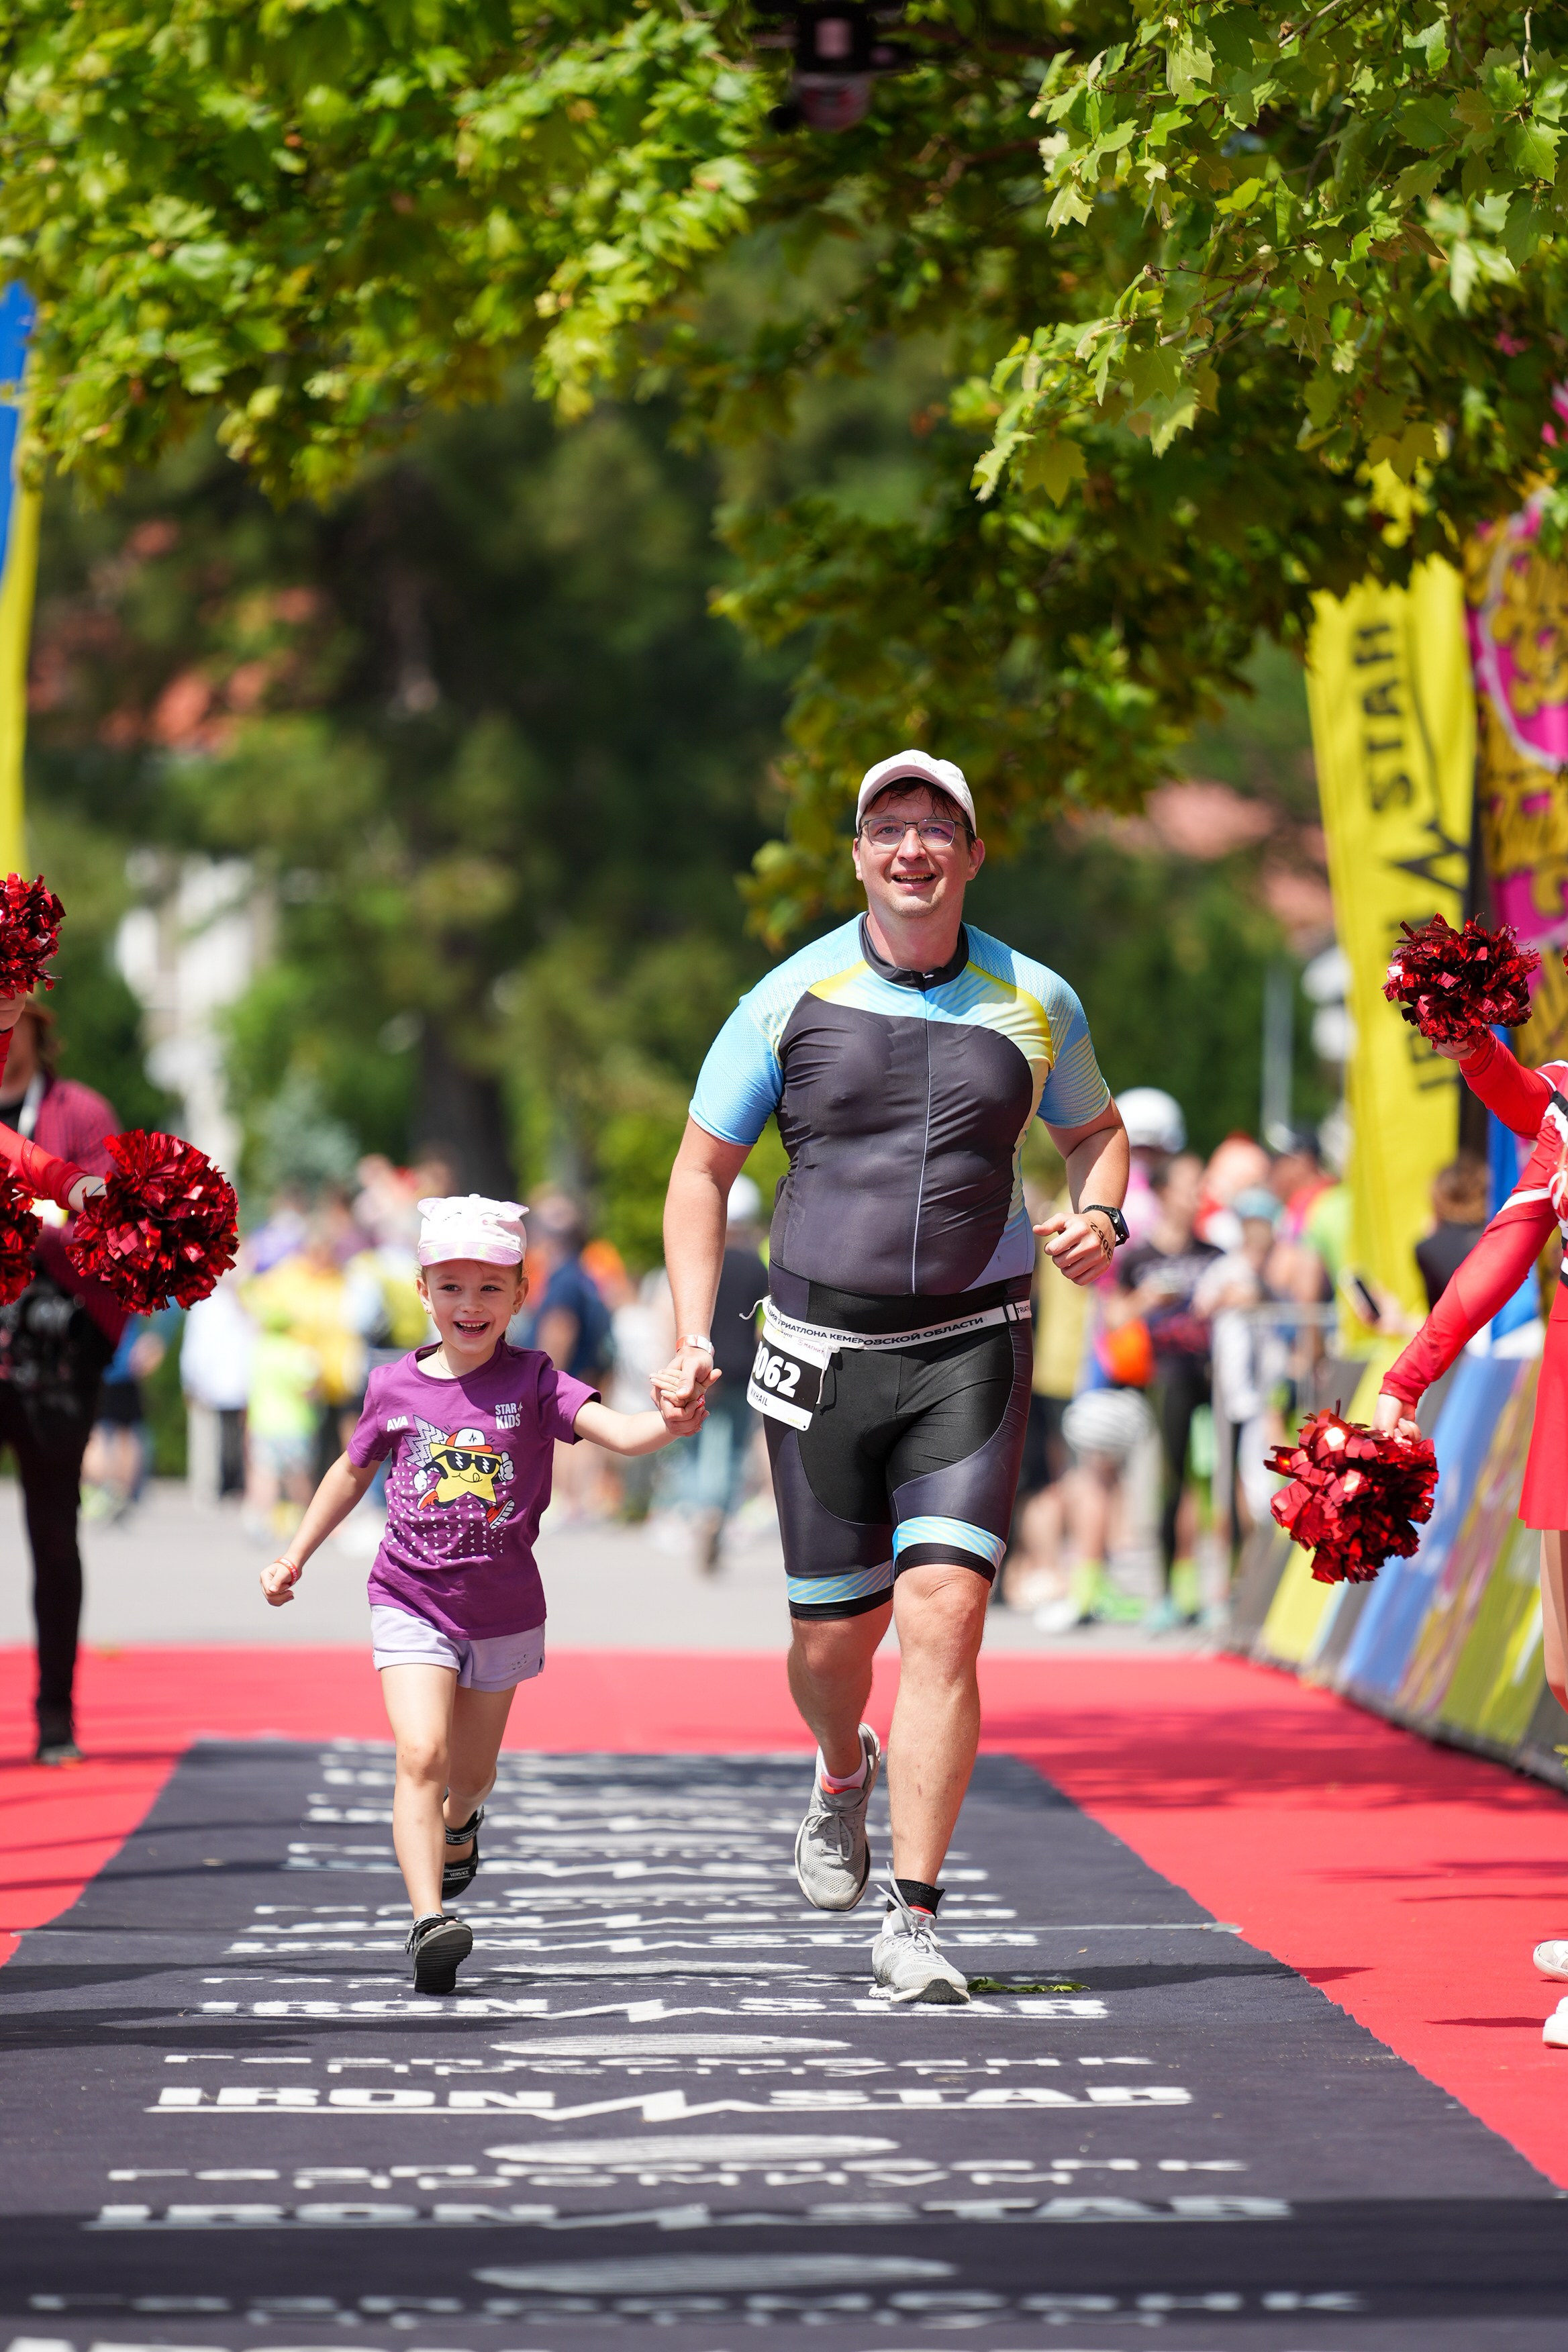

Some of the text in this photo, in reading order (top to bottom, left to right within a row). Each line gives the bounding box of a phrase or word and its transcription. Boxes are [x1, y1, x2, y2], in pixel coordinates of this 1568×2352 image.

[1352, 621, 1416, 814] STAR
[1090, 1222, 1112, 1260] 3062
[778, 1318, 828, 1338] ТРИАТЛОНА
[830, 1332, 920, 1346] КЕМЕРОВСКОЙ
[923, 1317, 984, 1338] ОБЛАСТИ
[495, 1403, 518, 1415] STAR
[387, 1416, 409, 1432] AVA
[496, 1414, 522, 1429] KIDS
[197, 1999, 549, 2014] IRON
[156, 2086, 1193, 2108] IRON STAR
[99, 2204, 558, 2226] IRON
